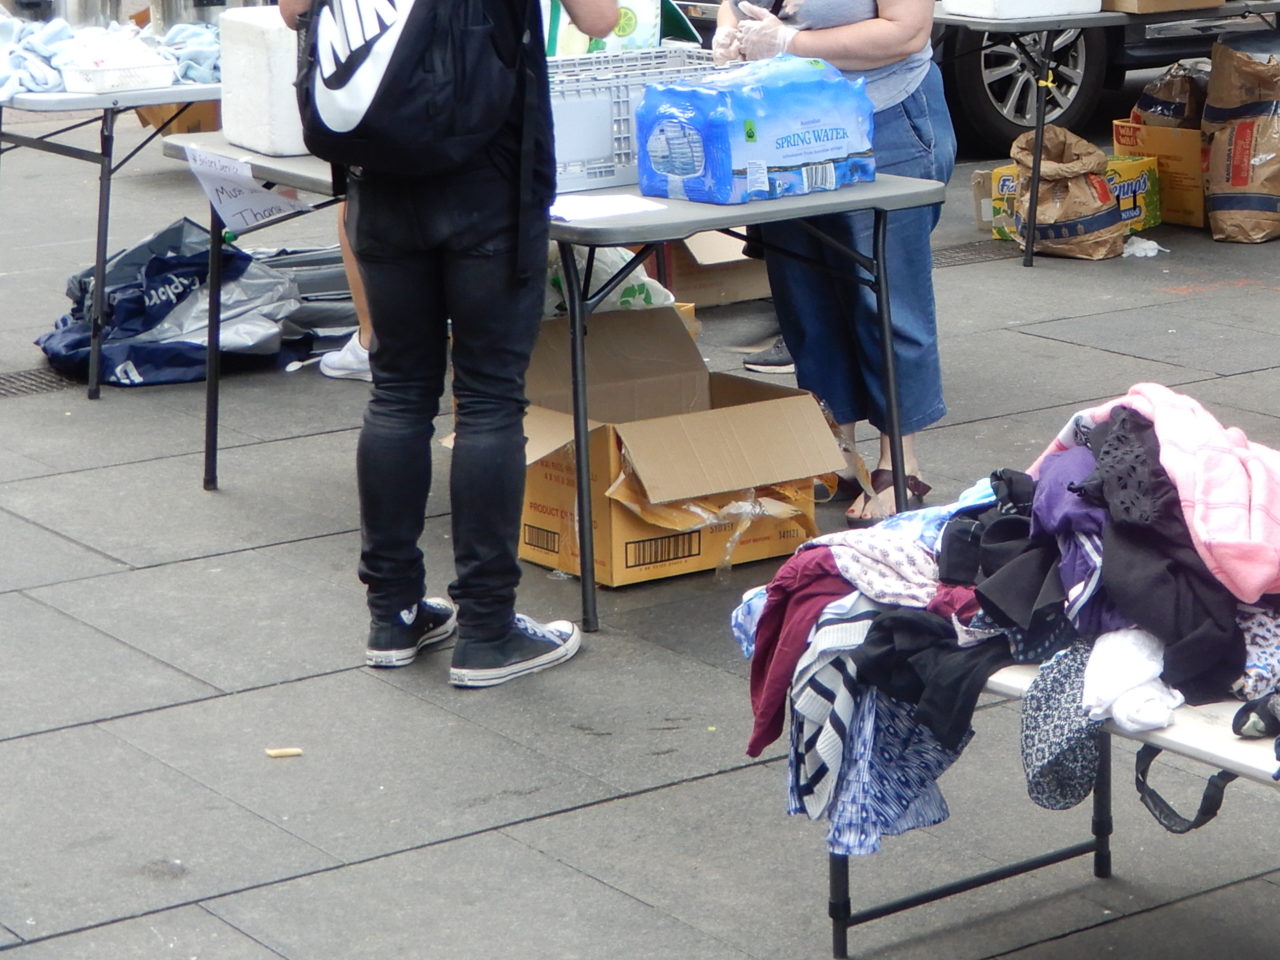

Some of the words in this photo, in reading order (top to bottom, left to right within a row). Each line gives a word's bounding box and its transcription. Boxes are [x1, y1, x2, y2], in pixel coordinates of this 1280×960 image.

[775, 130, 811, 150] SPRING
[813, 127, 849, 144] WATER
[529, 501, 560, 518] PRODUCT
